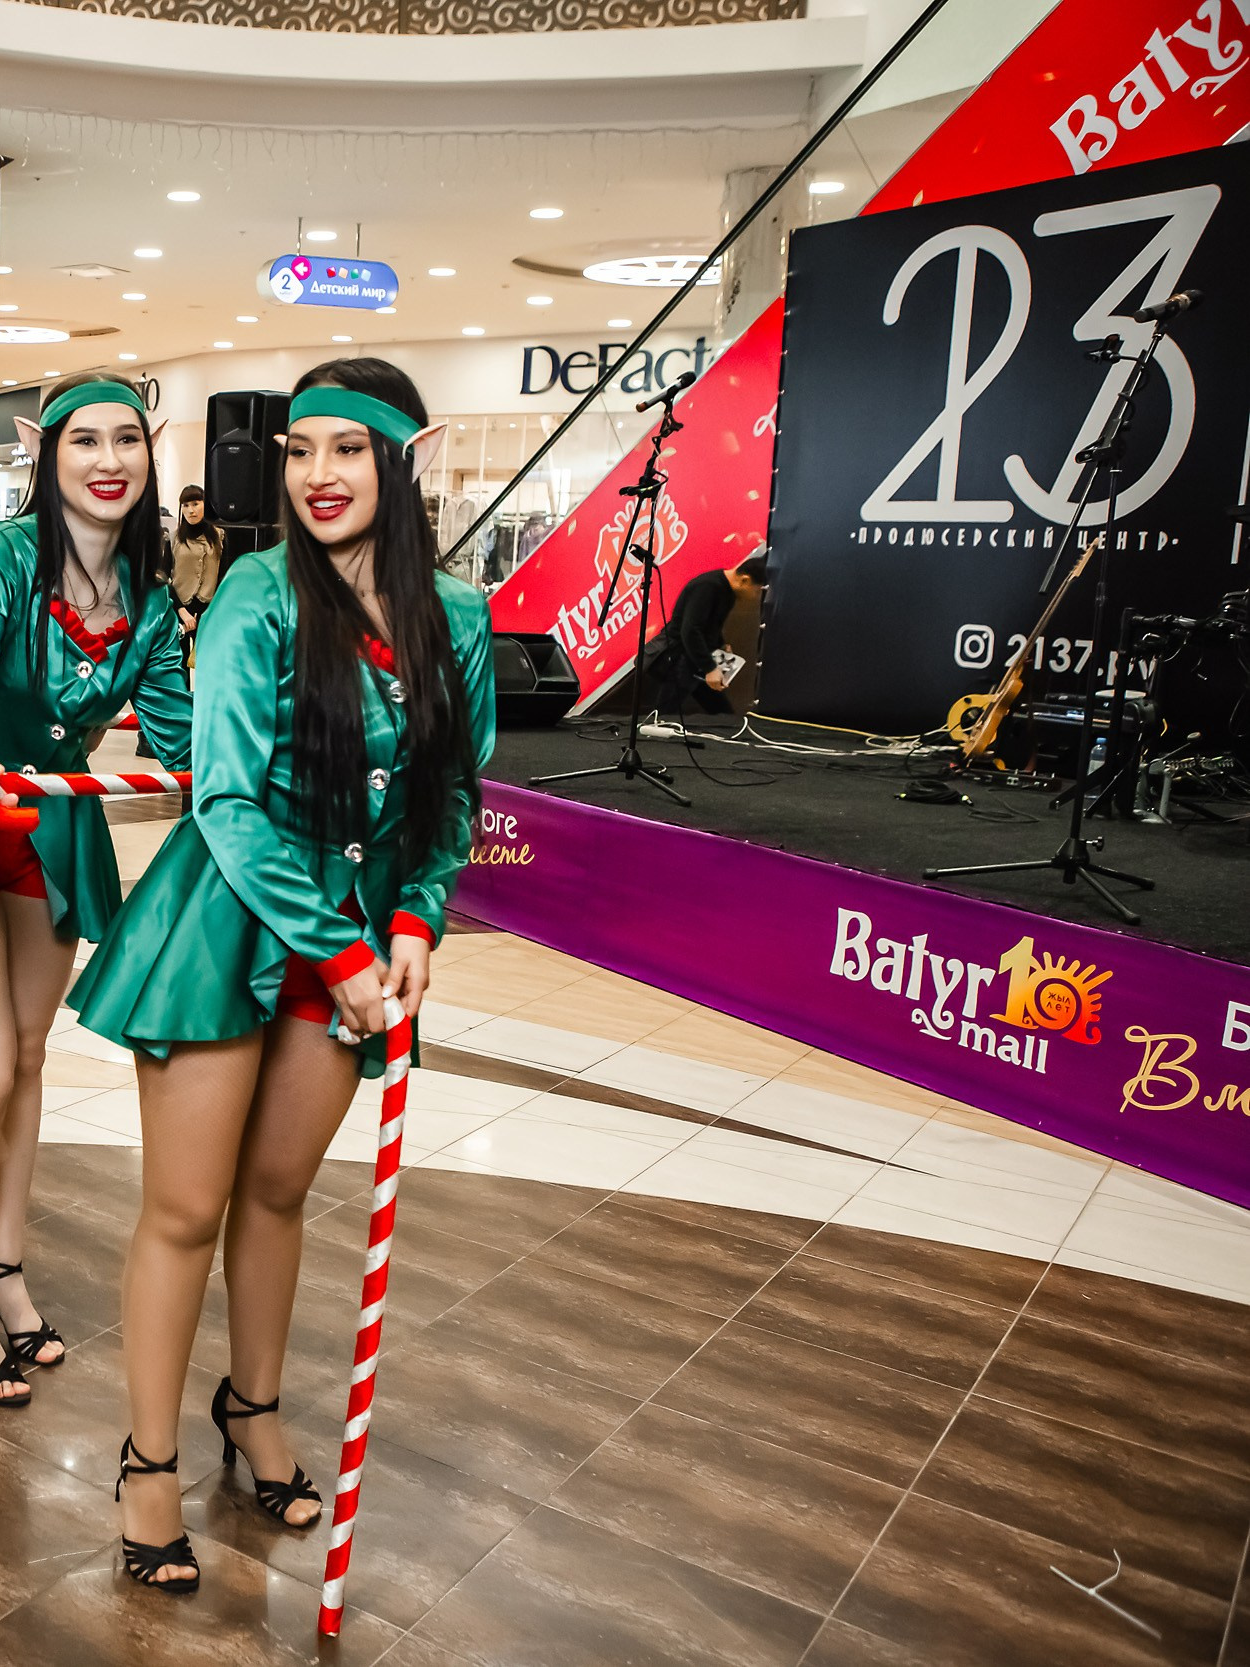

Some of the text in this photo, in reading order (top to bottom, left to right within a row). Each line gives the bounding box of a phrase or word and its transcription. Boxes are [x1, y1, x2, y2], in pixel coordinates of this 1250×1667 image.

[281, 274, 291, 290] 2
[310, 280, 386, 302] Детский мир
[520, 336, 717, 395] DeFact
[601, 585, 651, 641] mal
[829, 907, 996, 1040] Batyr
[958, 1020, 1049, 1074] mall
